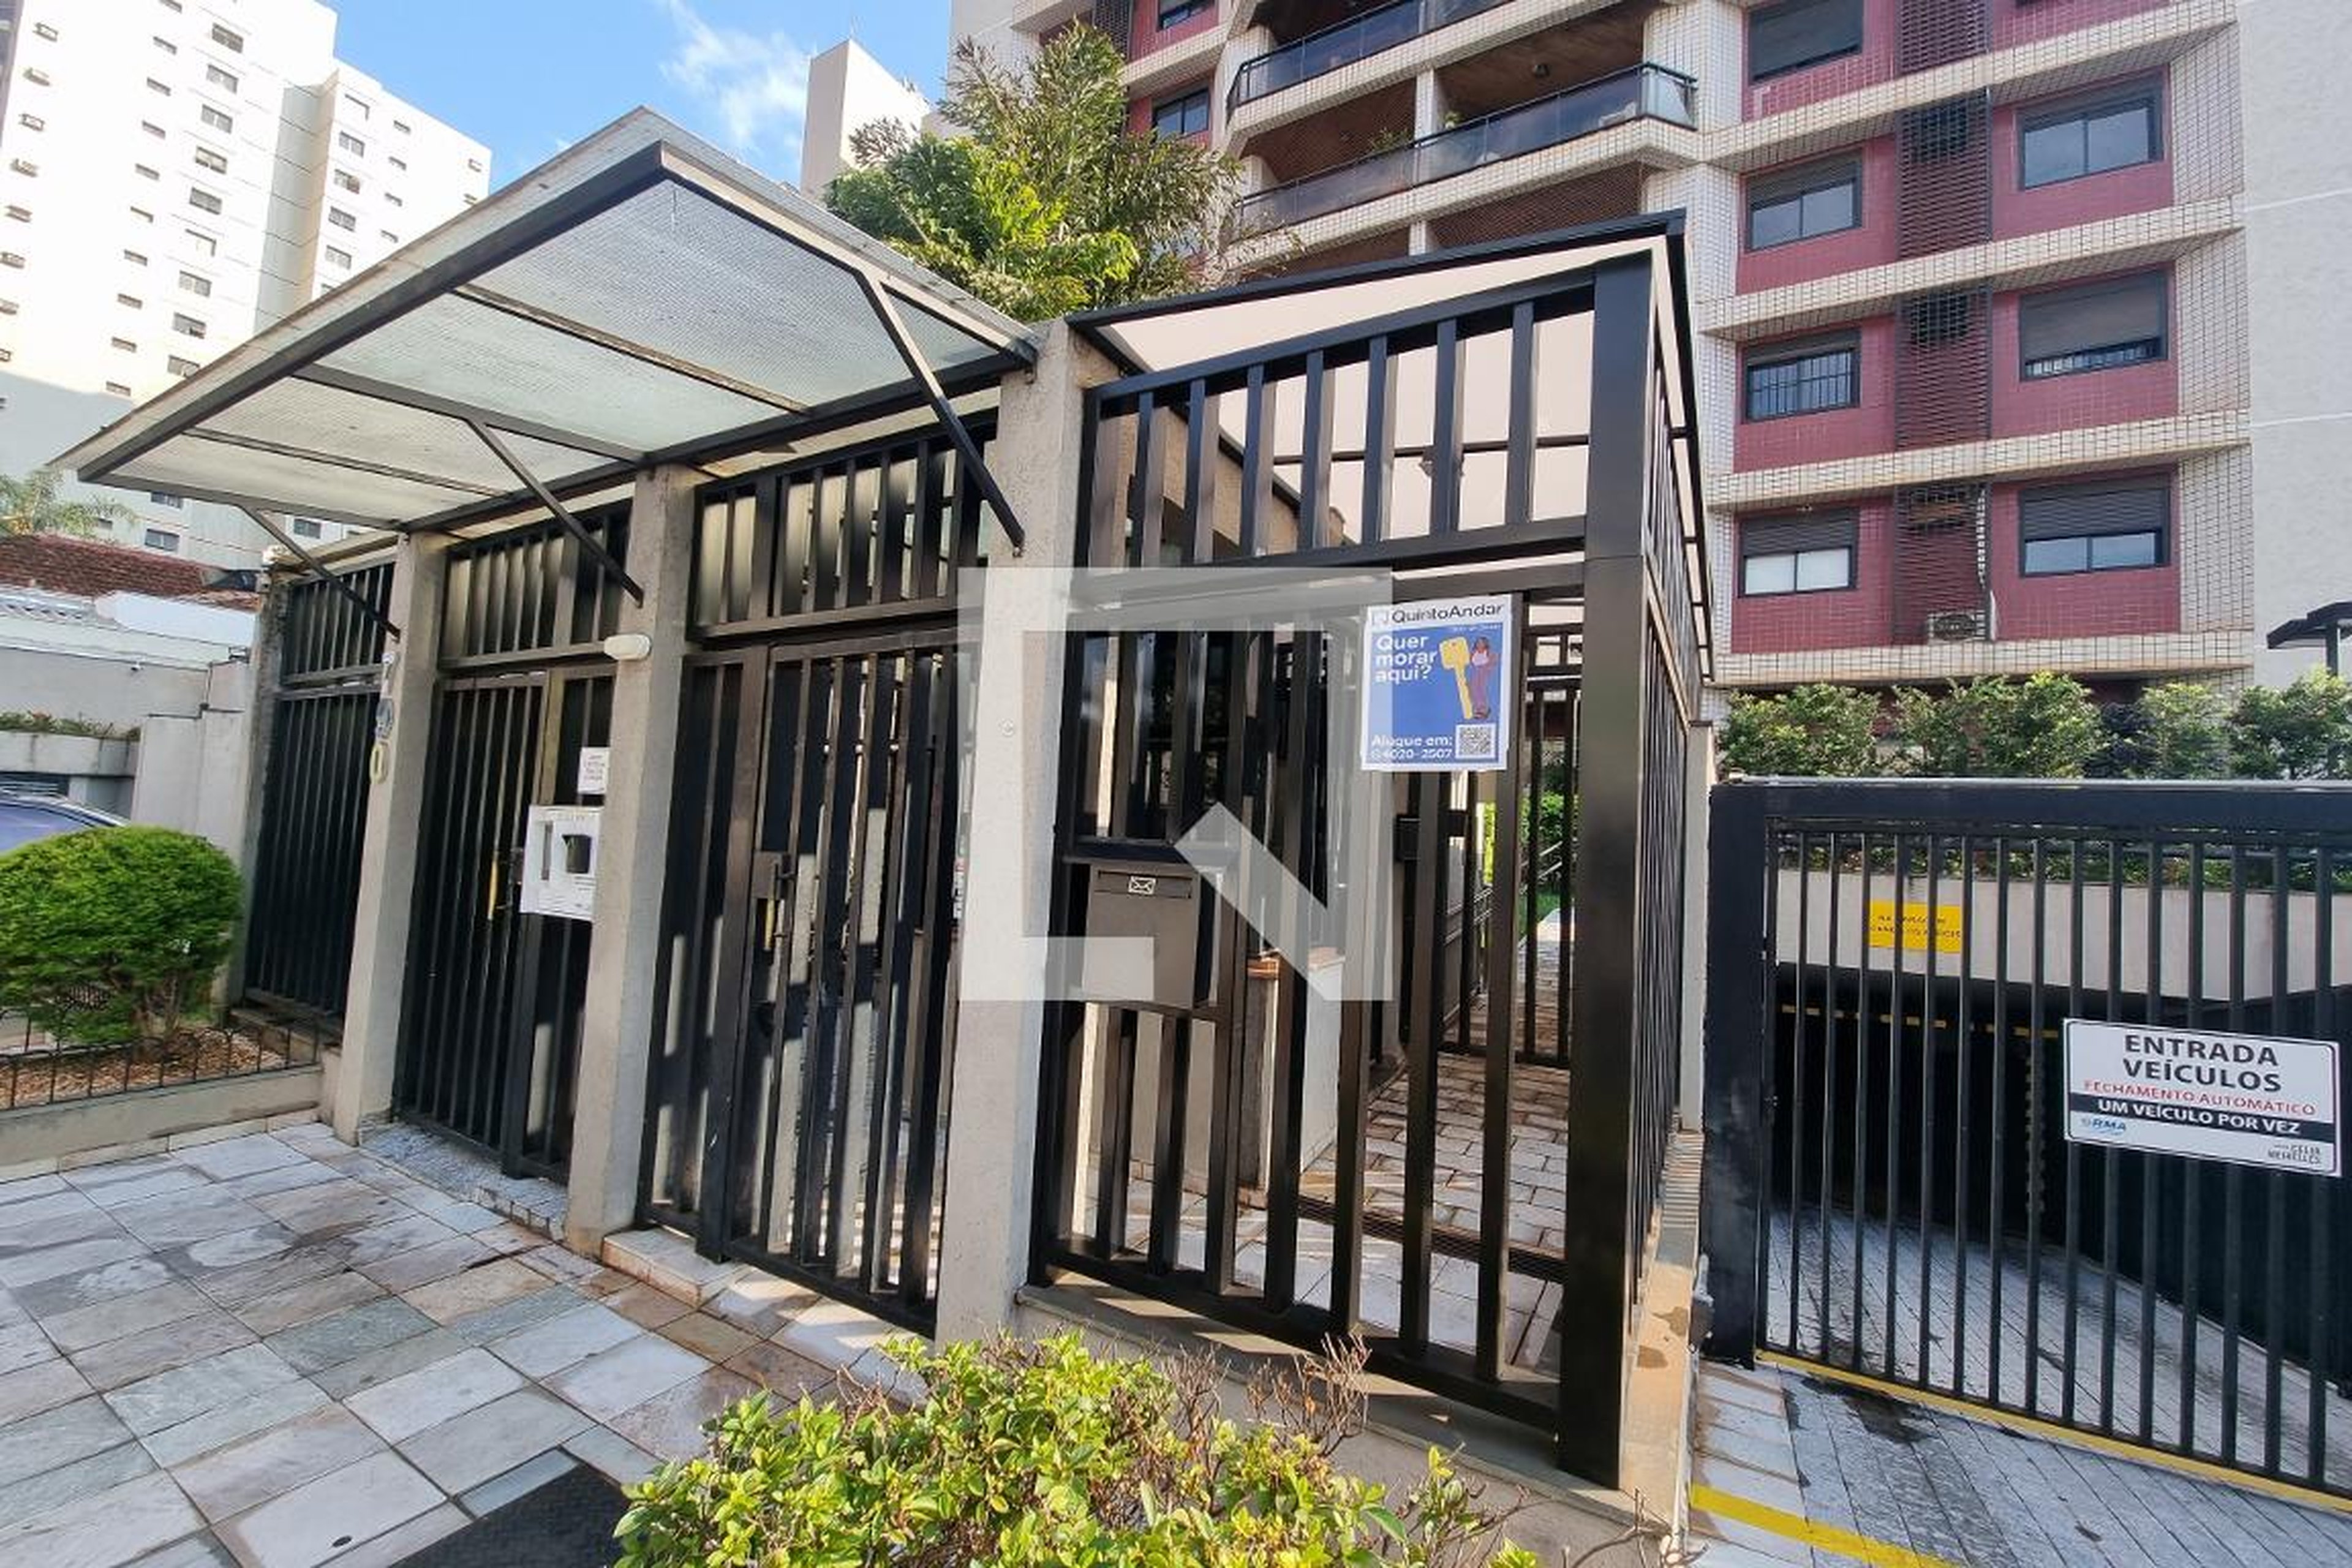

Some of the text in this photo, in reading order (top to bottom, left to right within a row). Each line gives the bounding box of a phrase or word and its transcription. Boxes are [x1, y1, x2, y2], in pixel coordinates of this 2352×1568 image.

[1392, 604, 1502, 624] QuintoAndar
[1377, 635, 1429, 650] Quer
[1376, 650, 1436, 666] morar
[1375, 665, 1432, 684] aqui?
[1425, 736, 1453, 747] em:
[2125, 1035, 2278, 1066] ENTRADA
[2123, 1058, 2282, 1092] VEÍCULOS
[2084, 1080, 2195, 1101] FECHAMENTO
[2092, 1118, 2127, 1131] RMA
[2098, 1099, 2129, 1114] UM
[2218, 1113, 2259, 1130] POR
[2262, 1118, 2302, 1133] VEZ
